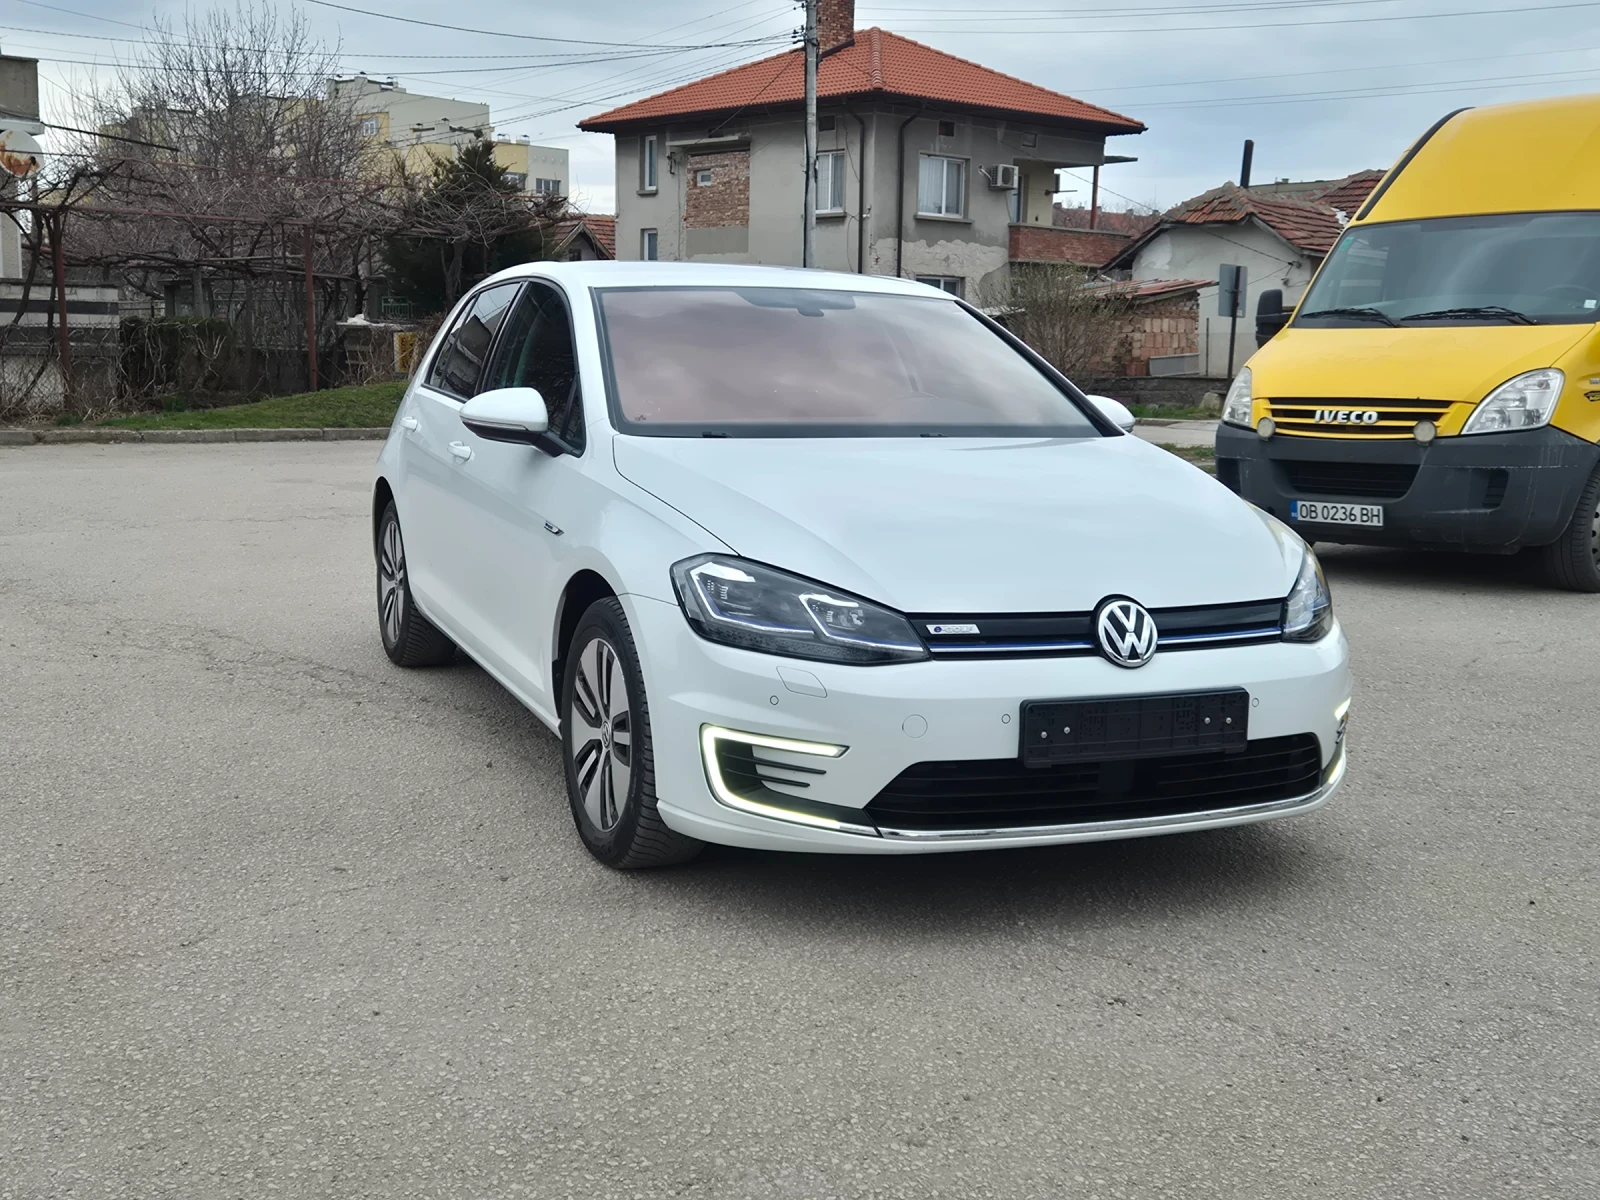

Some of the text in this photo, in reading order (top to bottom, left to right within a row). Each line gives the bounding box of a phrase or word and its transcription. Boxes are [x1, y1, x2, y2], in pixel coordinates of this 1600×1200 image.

[1314, 410, 1378, 424] IVECO
[1300, 503, 1381, 524] OB 0236 BH
